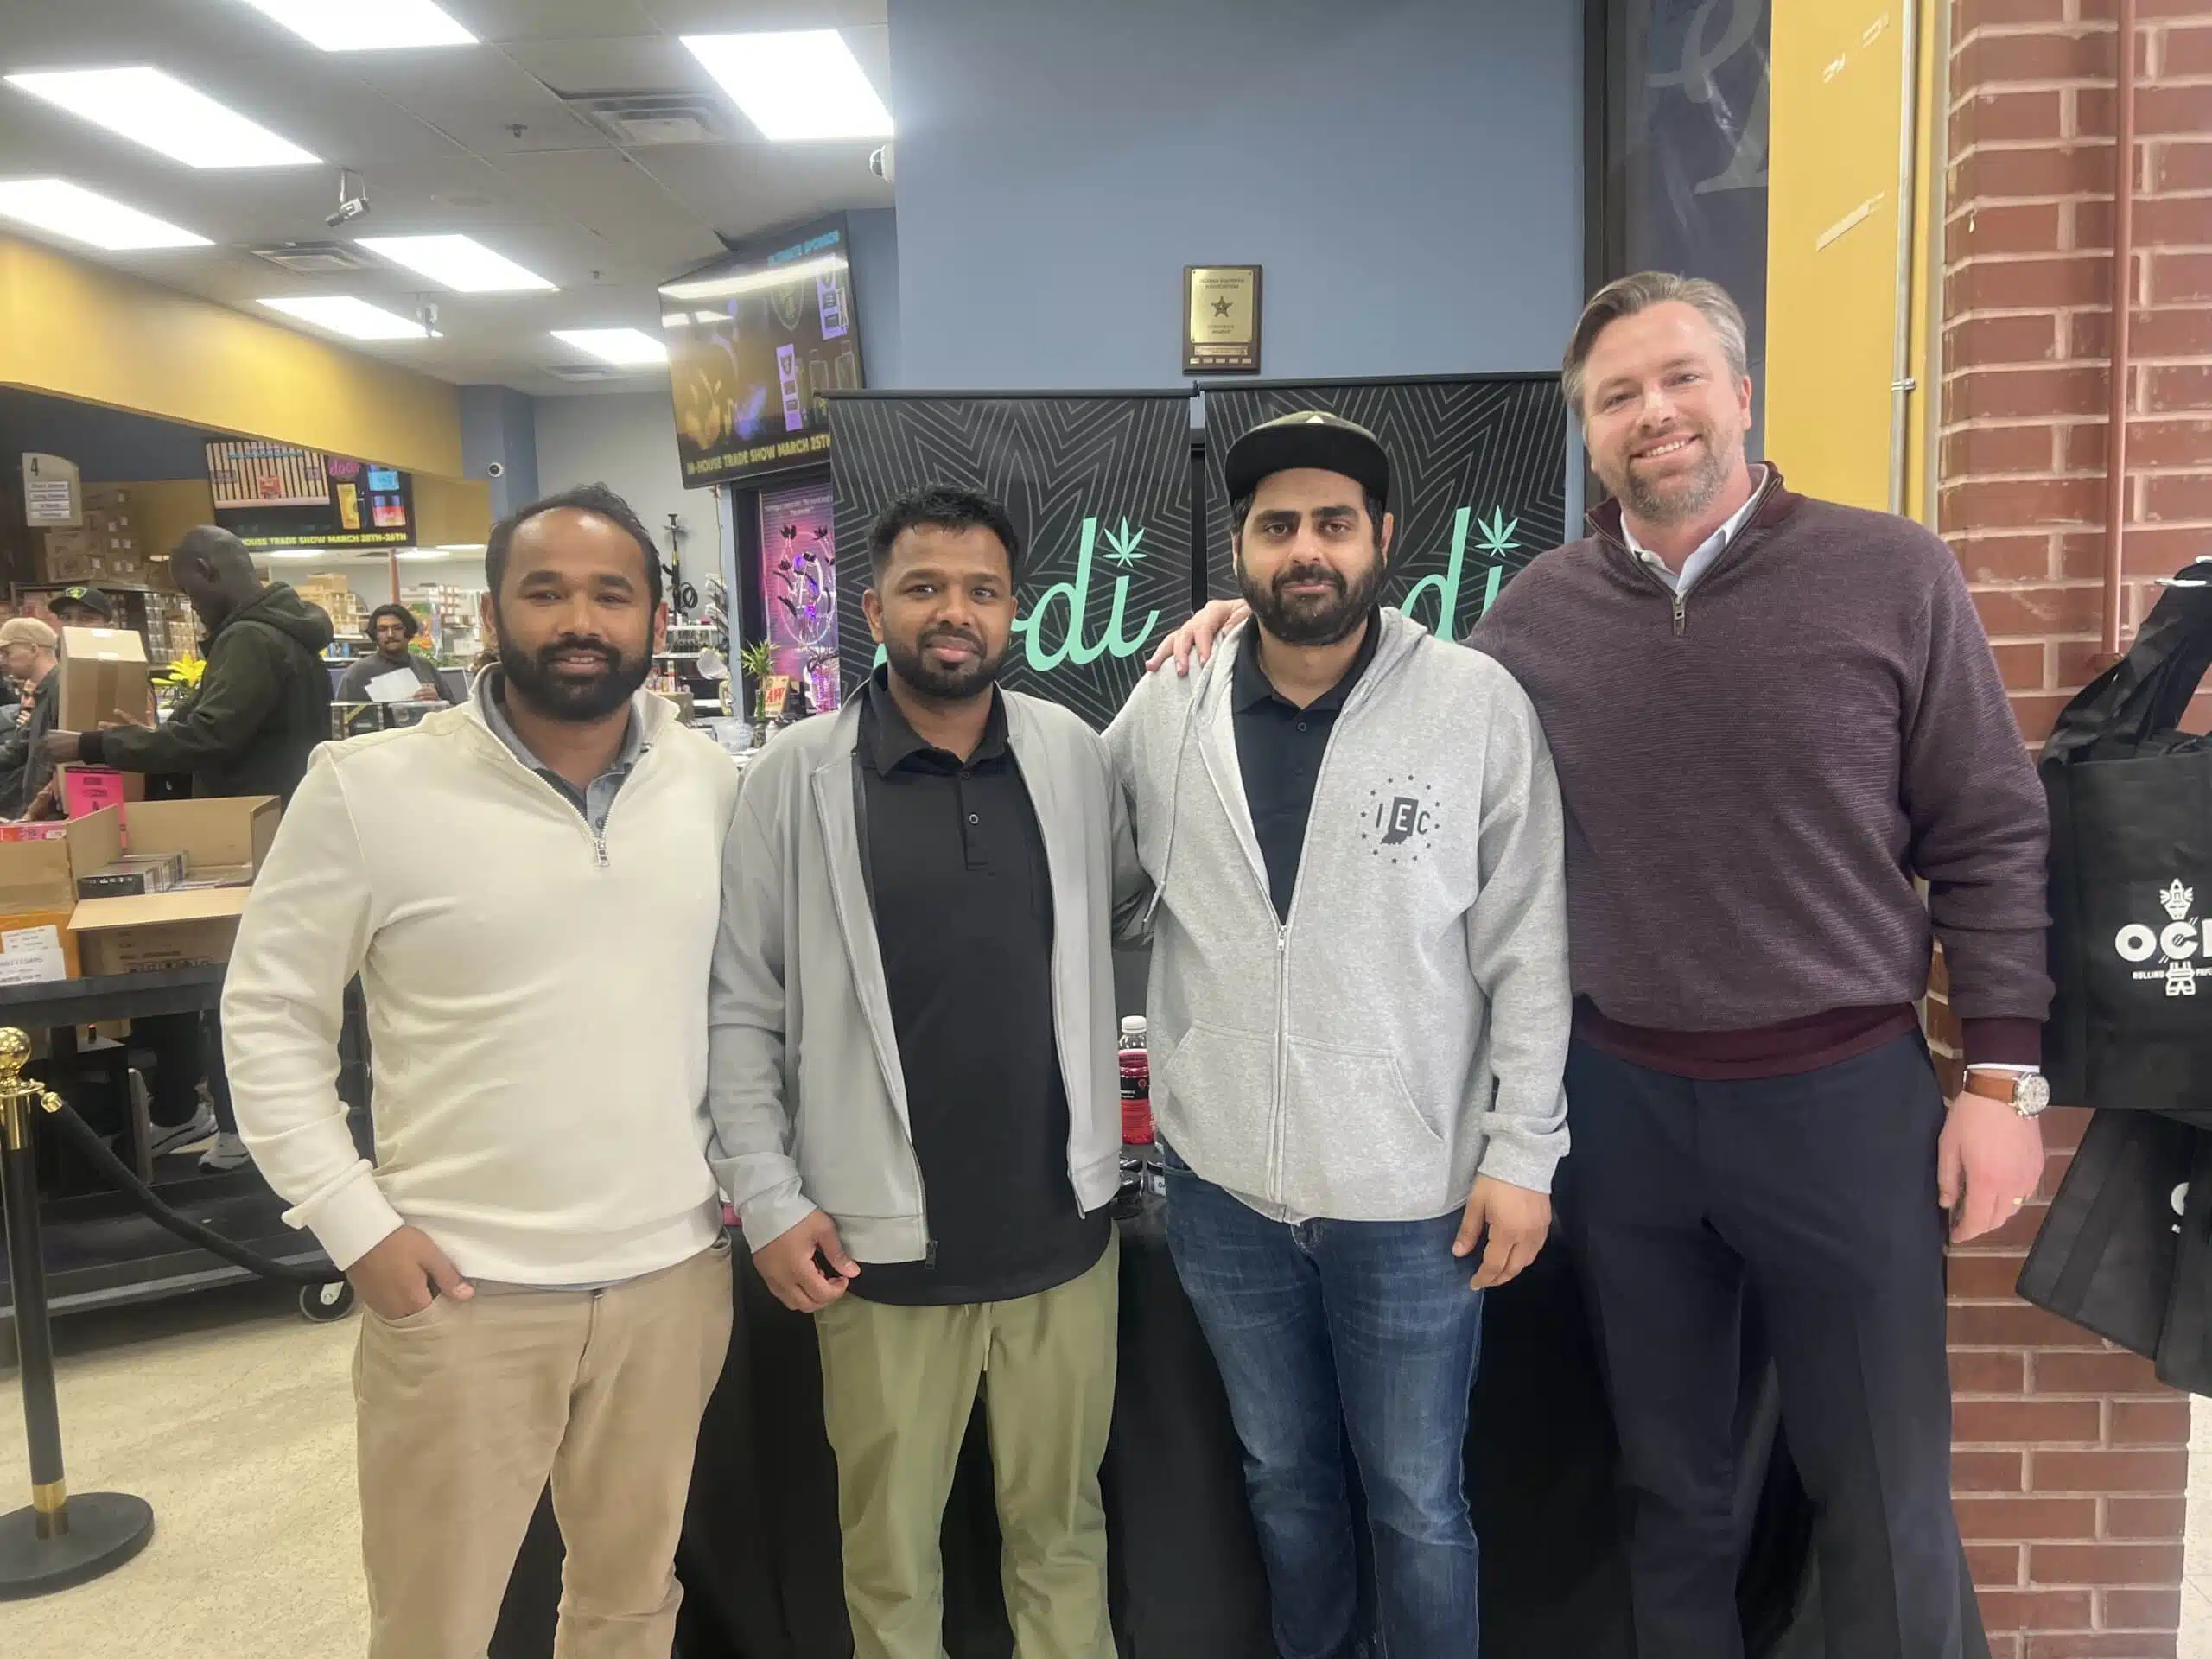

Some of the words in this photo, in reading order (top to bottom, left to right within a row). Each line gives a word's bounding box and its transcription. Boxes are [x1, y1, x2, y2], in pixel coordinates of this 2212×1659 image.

[724, 449, 749, 467] TRADE
[749, 444, 775, 462] SHOW
[777, 437, 810, 457] MARCH
[30, 457, 39, 476] 4
[241, 537, 268, 546] OUSE
[269, 537, 297, 546] TRADE
[298, 536, 326, 545] SHOW
[327, 534, 359, 543] MARCH
[766, 687, 785, 702] AW
[1375, 802, 1432, 836] IEC
